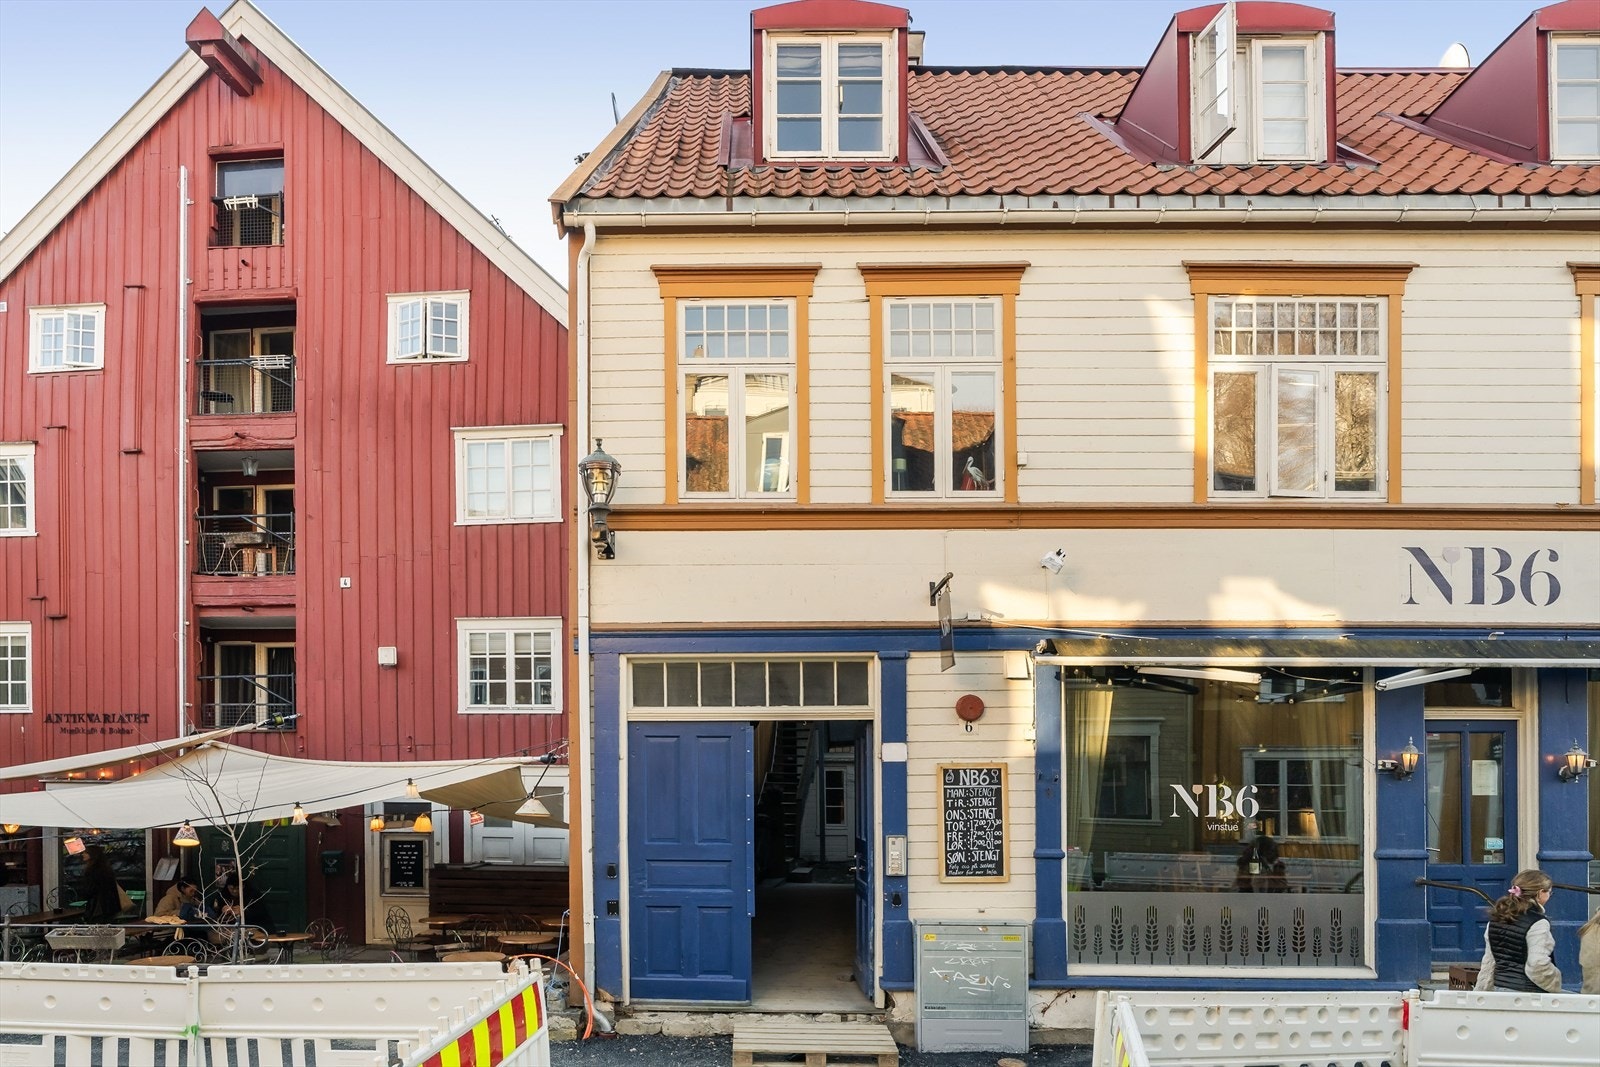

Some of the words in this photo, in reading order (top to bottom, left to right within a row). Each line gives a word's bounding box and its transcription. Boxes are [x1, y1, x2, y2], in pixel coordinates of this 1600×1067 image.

[1401, 546, 1561, 607] NB6
[44, 713, 150, 723] ANTIKVARIATET
[100, 727, 106, 735] &
[965, 721, 974, 733] 6
[959, 769, 990, 786] NB6
[1169, 784, 1260, 818] NB6
[1207, 823, 1239, 831] vinstue
